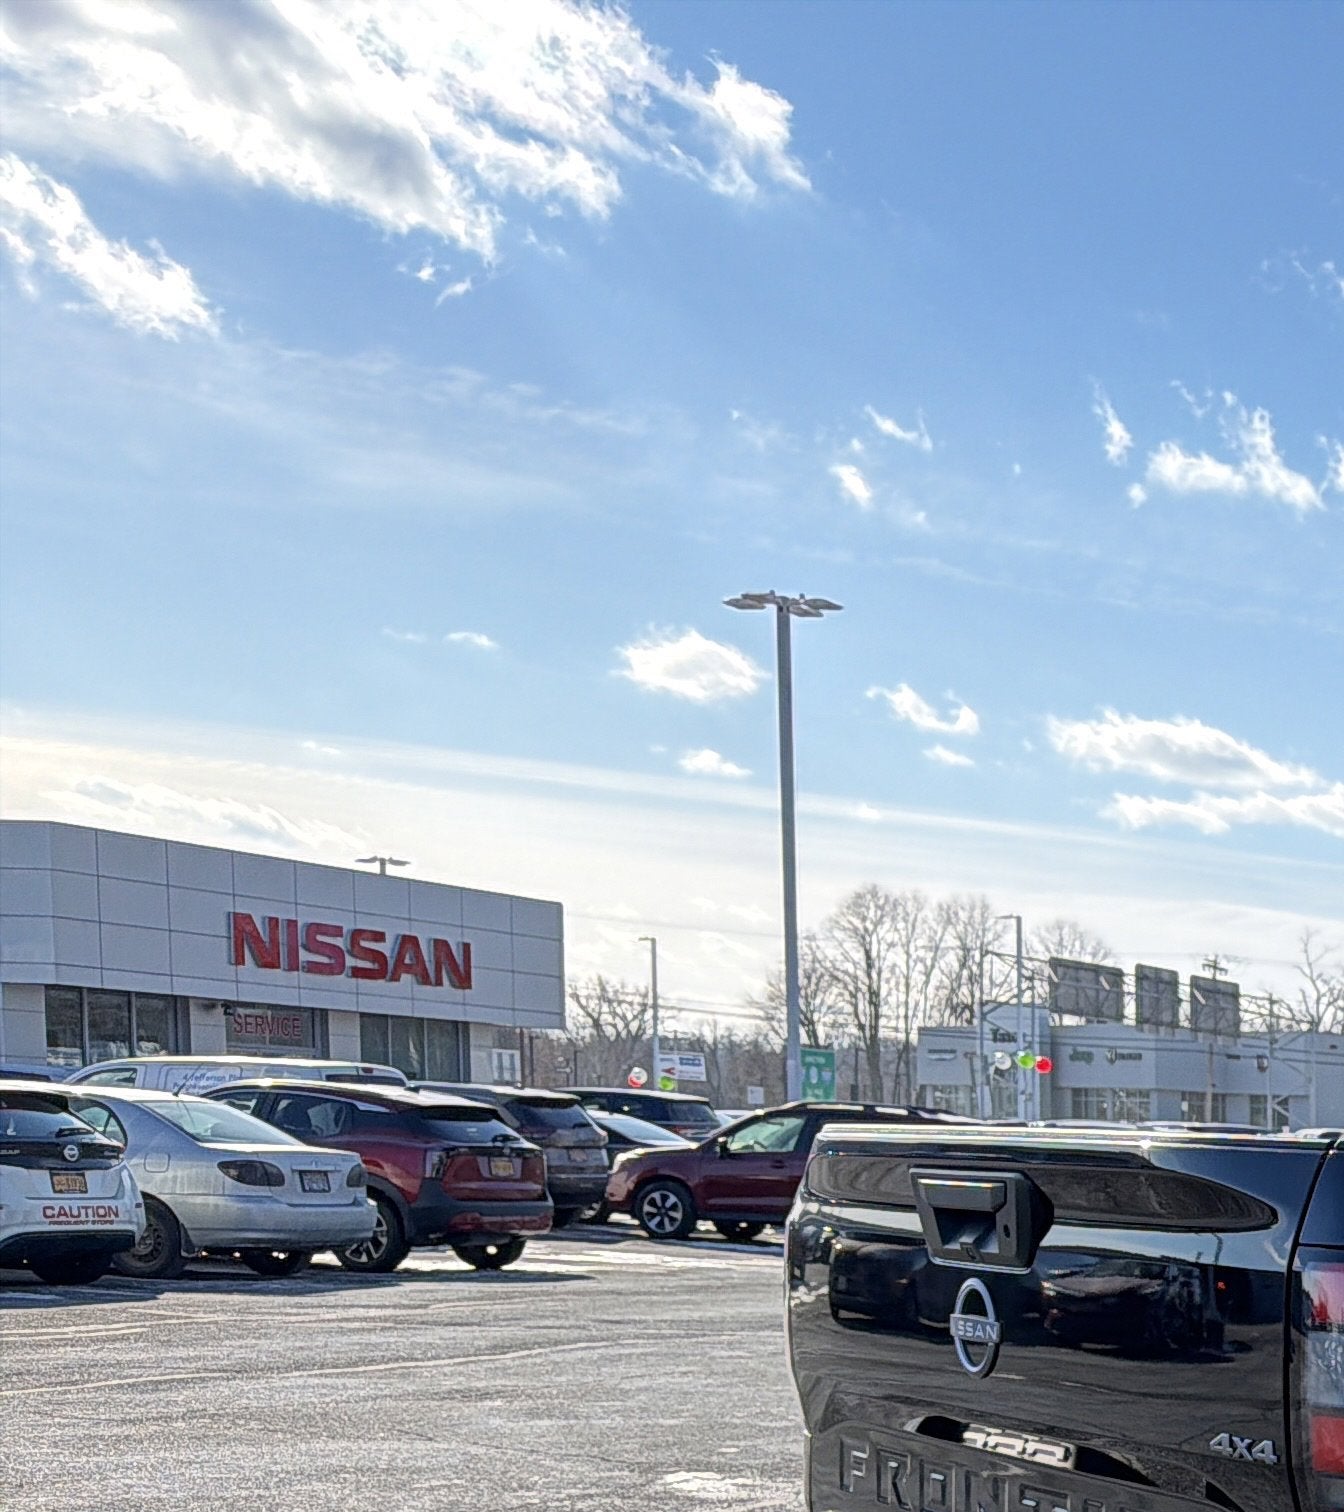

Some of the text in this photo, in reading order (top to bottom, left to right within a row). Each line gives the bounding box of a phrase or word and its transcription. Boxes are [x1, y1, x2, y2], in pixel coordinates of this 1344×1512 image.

[230, 911, 472, 990] NISSAN
[233, 1013, 301, 1038] SERVICE
[42, 1205, 119, 1219] CAUTION
[953, 1317, 998, 1341] SSAN
